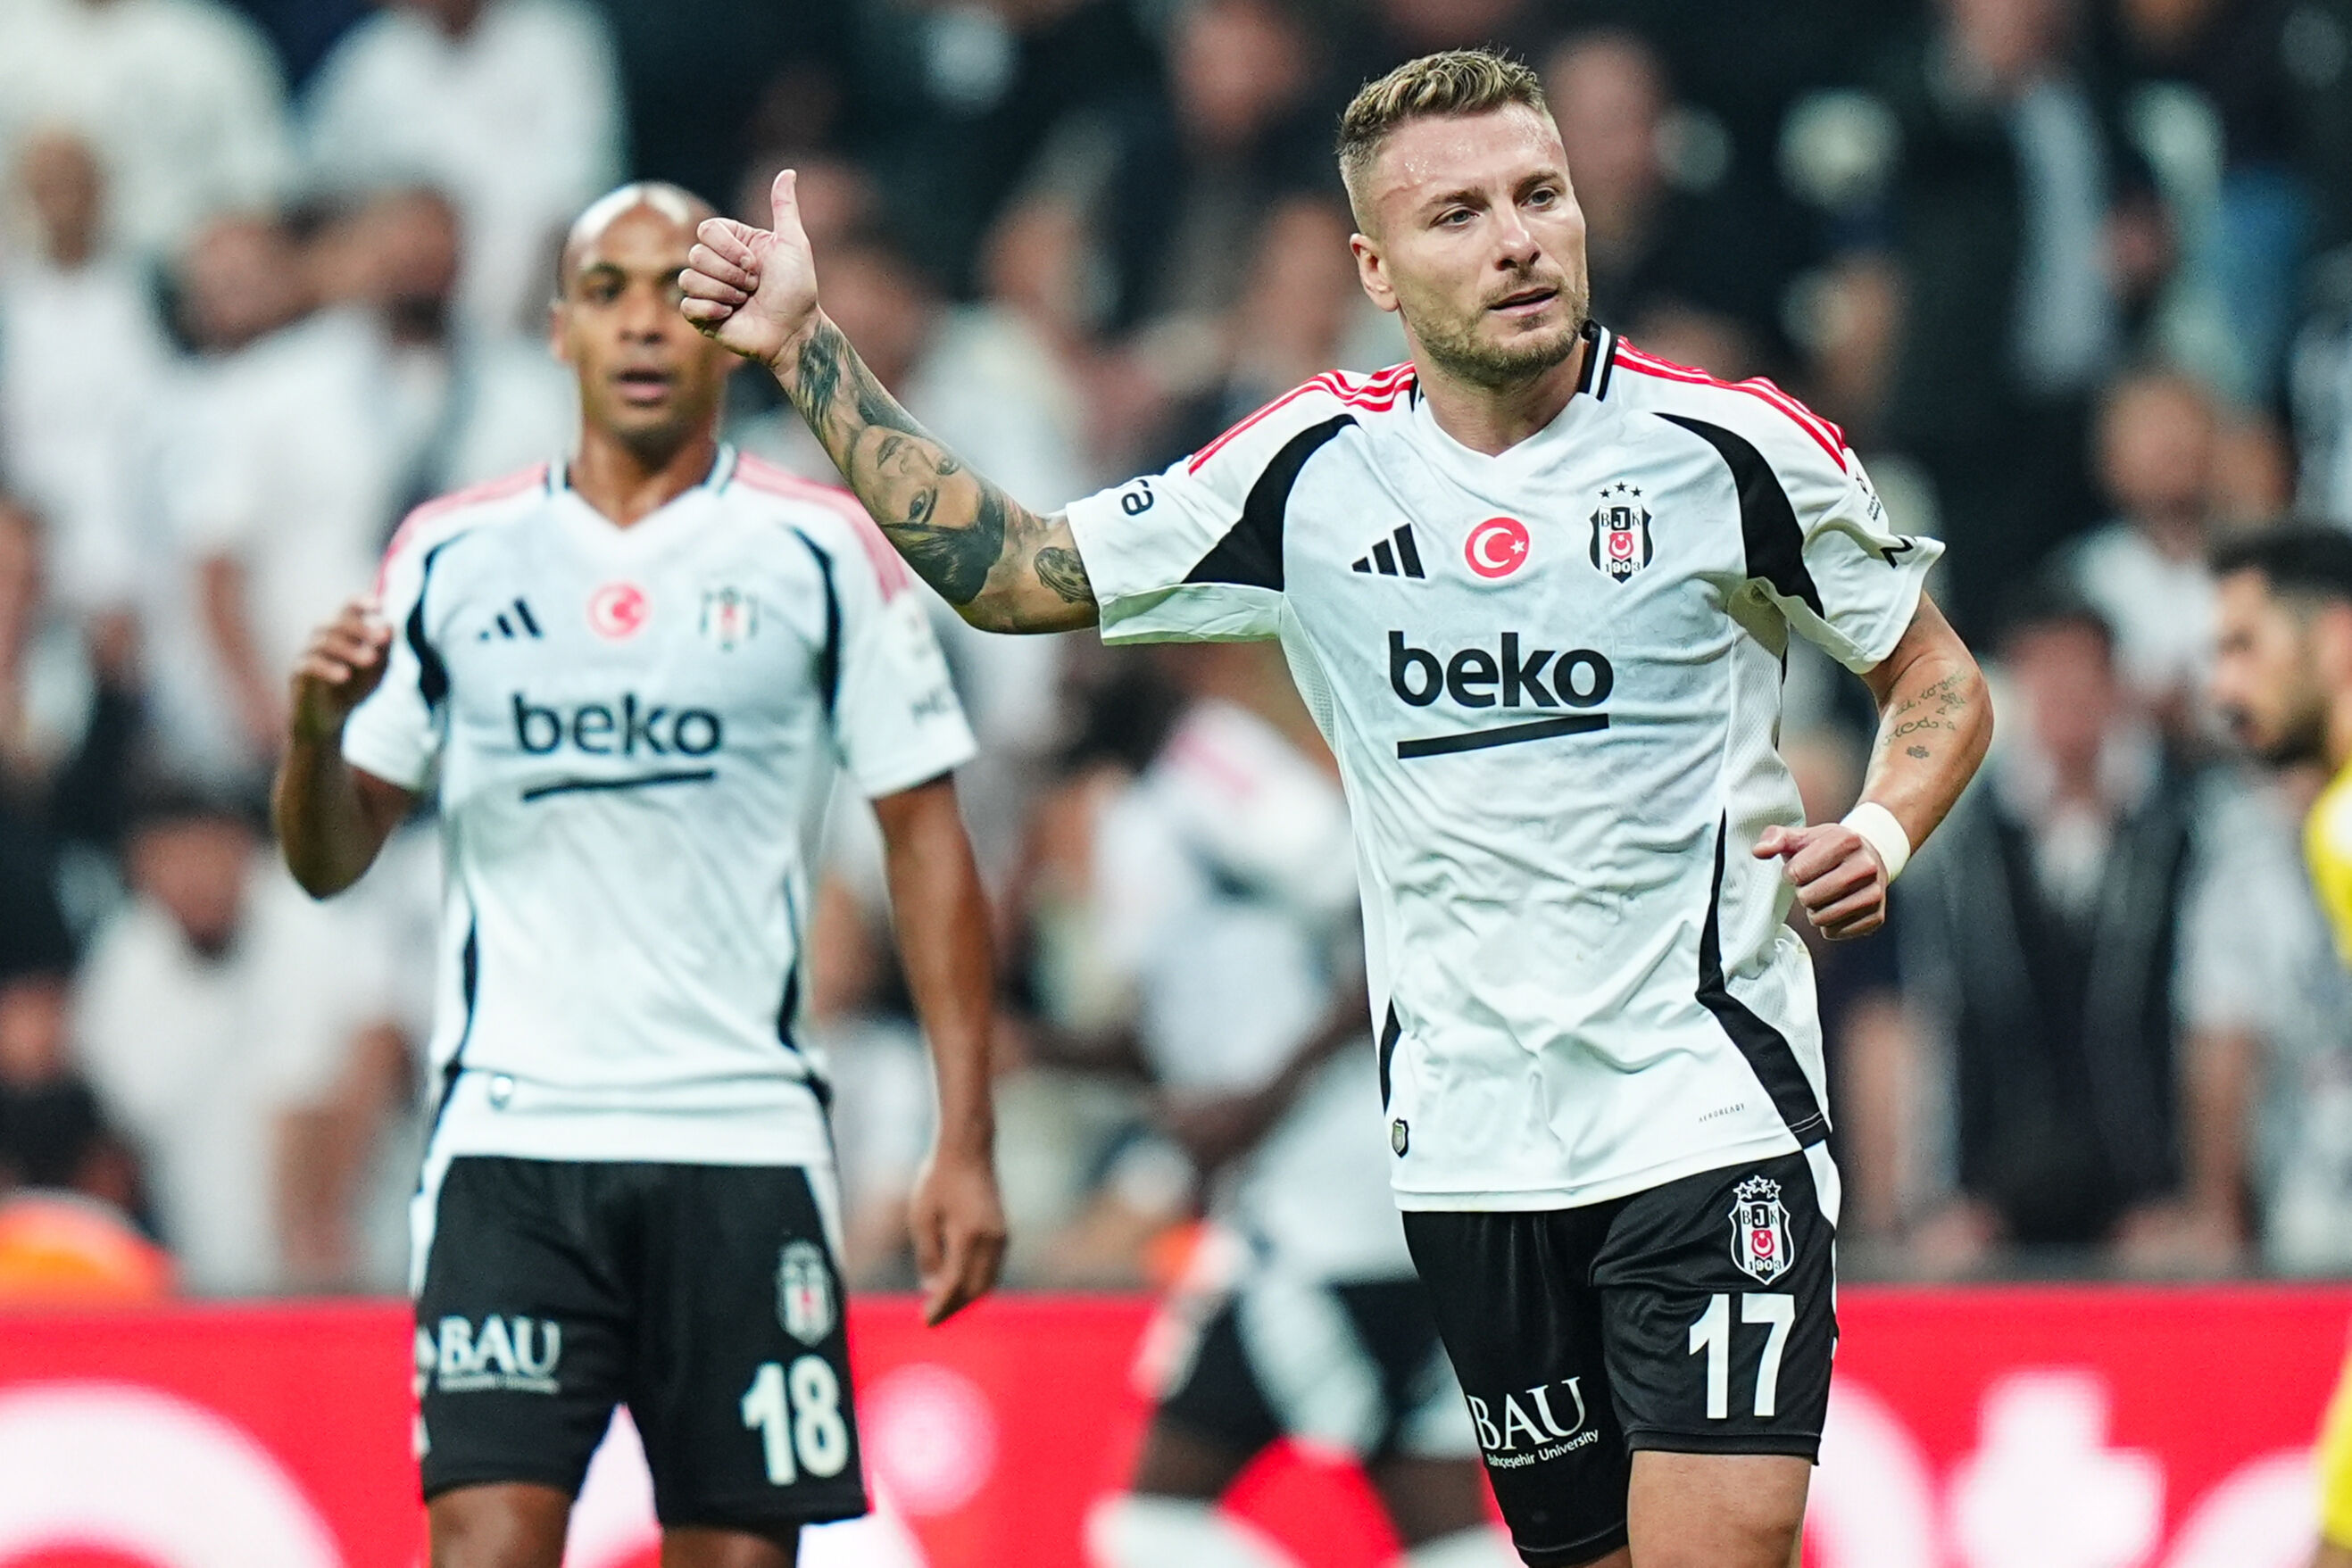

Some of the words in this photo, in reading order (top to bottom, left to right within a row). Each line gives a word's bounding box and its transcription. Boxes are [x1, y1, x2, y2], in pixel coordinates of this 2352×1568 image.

[1600, 511, 1641, 528] BJK
[1605, 561, 1641, 573] 1903
[1389, 630, 1614, 708] beko
[512, 692, 722, 756] beko
[1742, 1208, 1778, 1225] BJK
[1749, 1259, 1782, 1272] 1903
[438, 1313, 561, 1375] BAU
[1689, 1292, 1795, 1419] 17
[740, 1354, 850, 1487] 18
[1467, 1376, 1585, 1450] BAU
[1538, 1429, 1599, 1461] University
